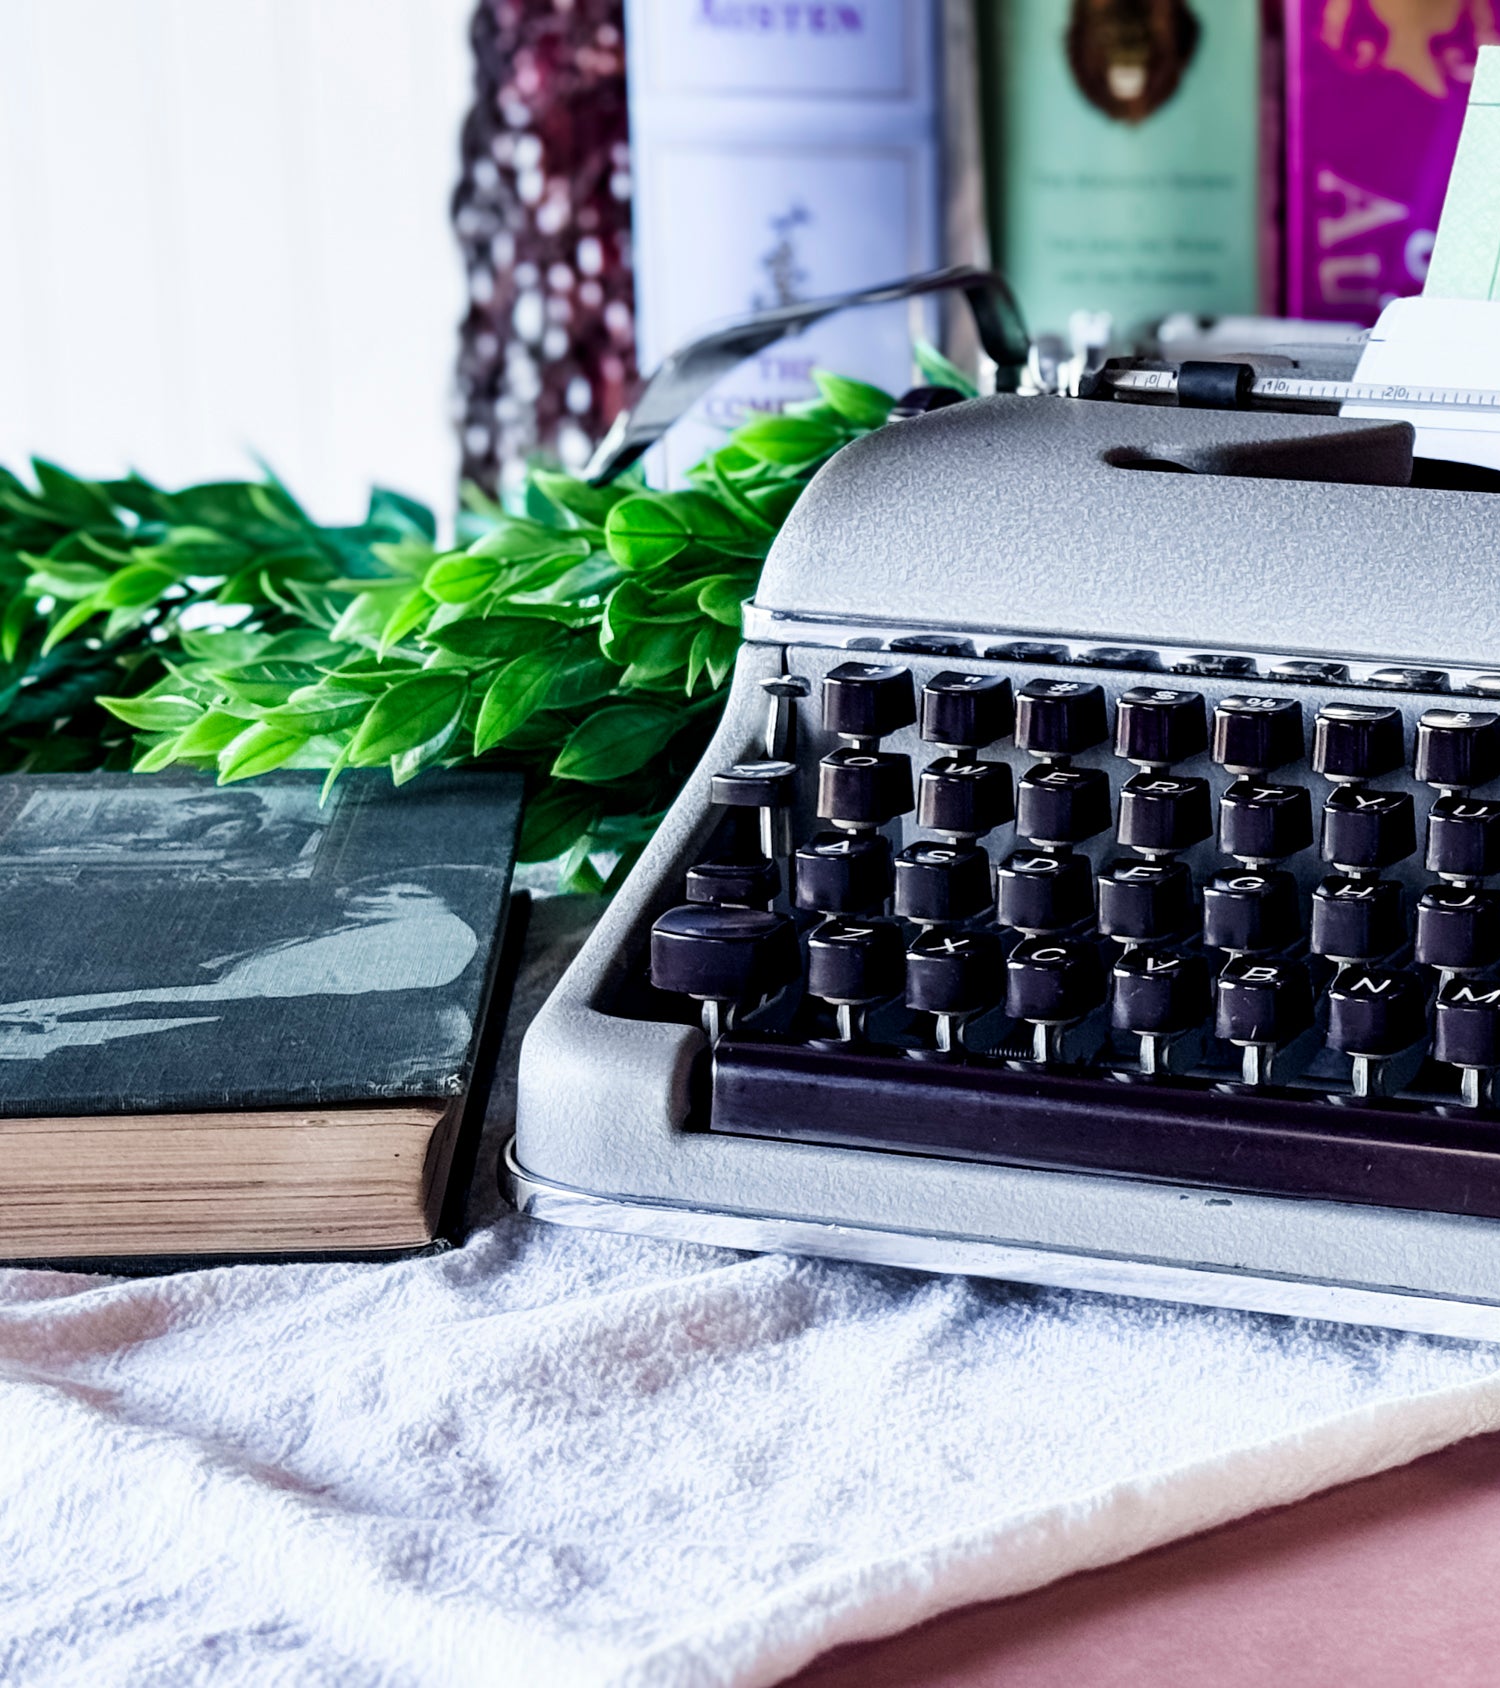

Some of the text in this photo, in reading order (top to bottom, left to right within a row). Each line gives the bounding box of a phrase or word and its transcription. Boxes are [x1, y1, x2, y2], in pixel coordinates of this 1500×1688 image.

[944, 762, 988, 775] W
[1040, 771, 1081, 785] E
[1139, 780, 1180, 792] R
[1252, 787, 1284, 801] T
[1452, 804, 1489, 817] U
[814, 839, 850, 854] A
[1020, 857, 1060, 871] D
[1121, 865, 1163, 879] F
[1226, 875, 1266, 891] G
[1334, 884, 1375, 899] H
[1438, 894, 1477, 908] J
[829, 926, 875, 942] Z
[925, 937, 971, 953] X
[1030, 947, 1067, 962] C
[1146, 956, 1180, 972] V
[1239, 966, 1279, 982] B
[1349, 976, 1393, 993] N
